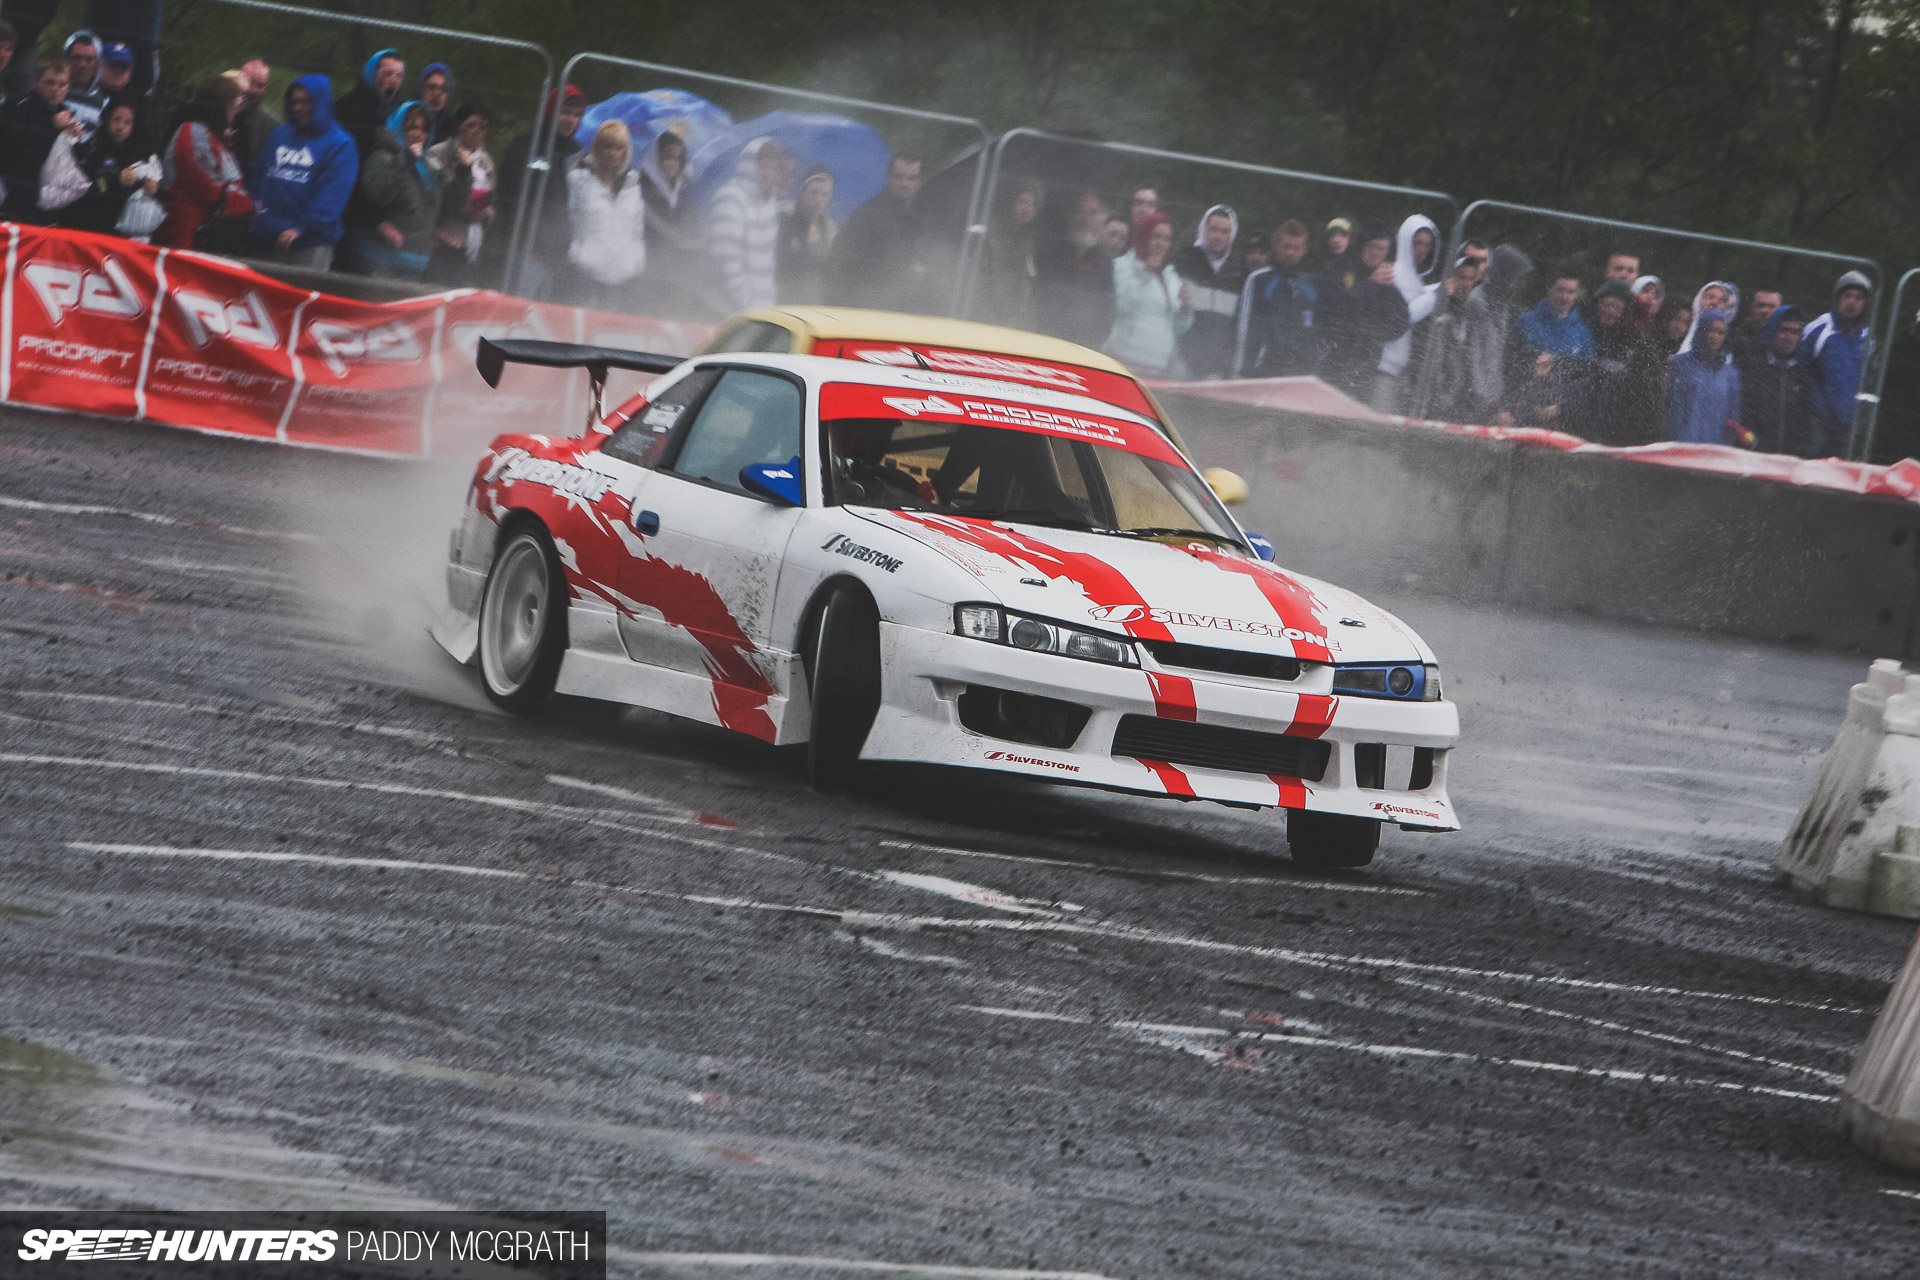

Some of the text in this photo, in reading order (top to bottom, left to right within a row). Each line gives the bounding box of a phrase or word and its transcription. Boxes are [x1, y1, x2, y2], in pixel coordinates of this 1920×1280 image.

[18, 335, 135, 368] PRODRIFT
[154, 358, 287, 394] PRODRIFT
[962, 401, 1120, 436] PRODRIFT
[835, 538, 904, 573] SILVERSTONE
[1149, 606, 1342, 652] SILVERSTONE
[1005, 753, 1081, 773] SILVERSTONE
[1385, 804, 1440, 820] SILVERSTONE
